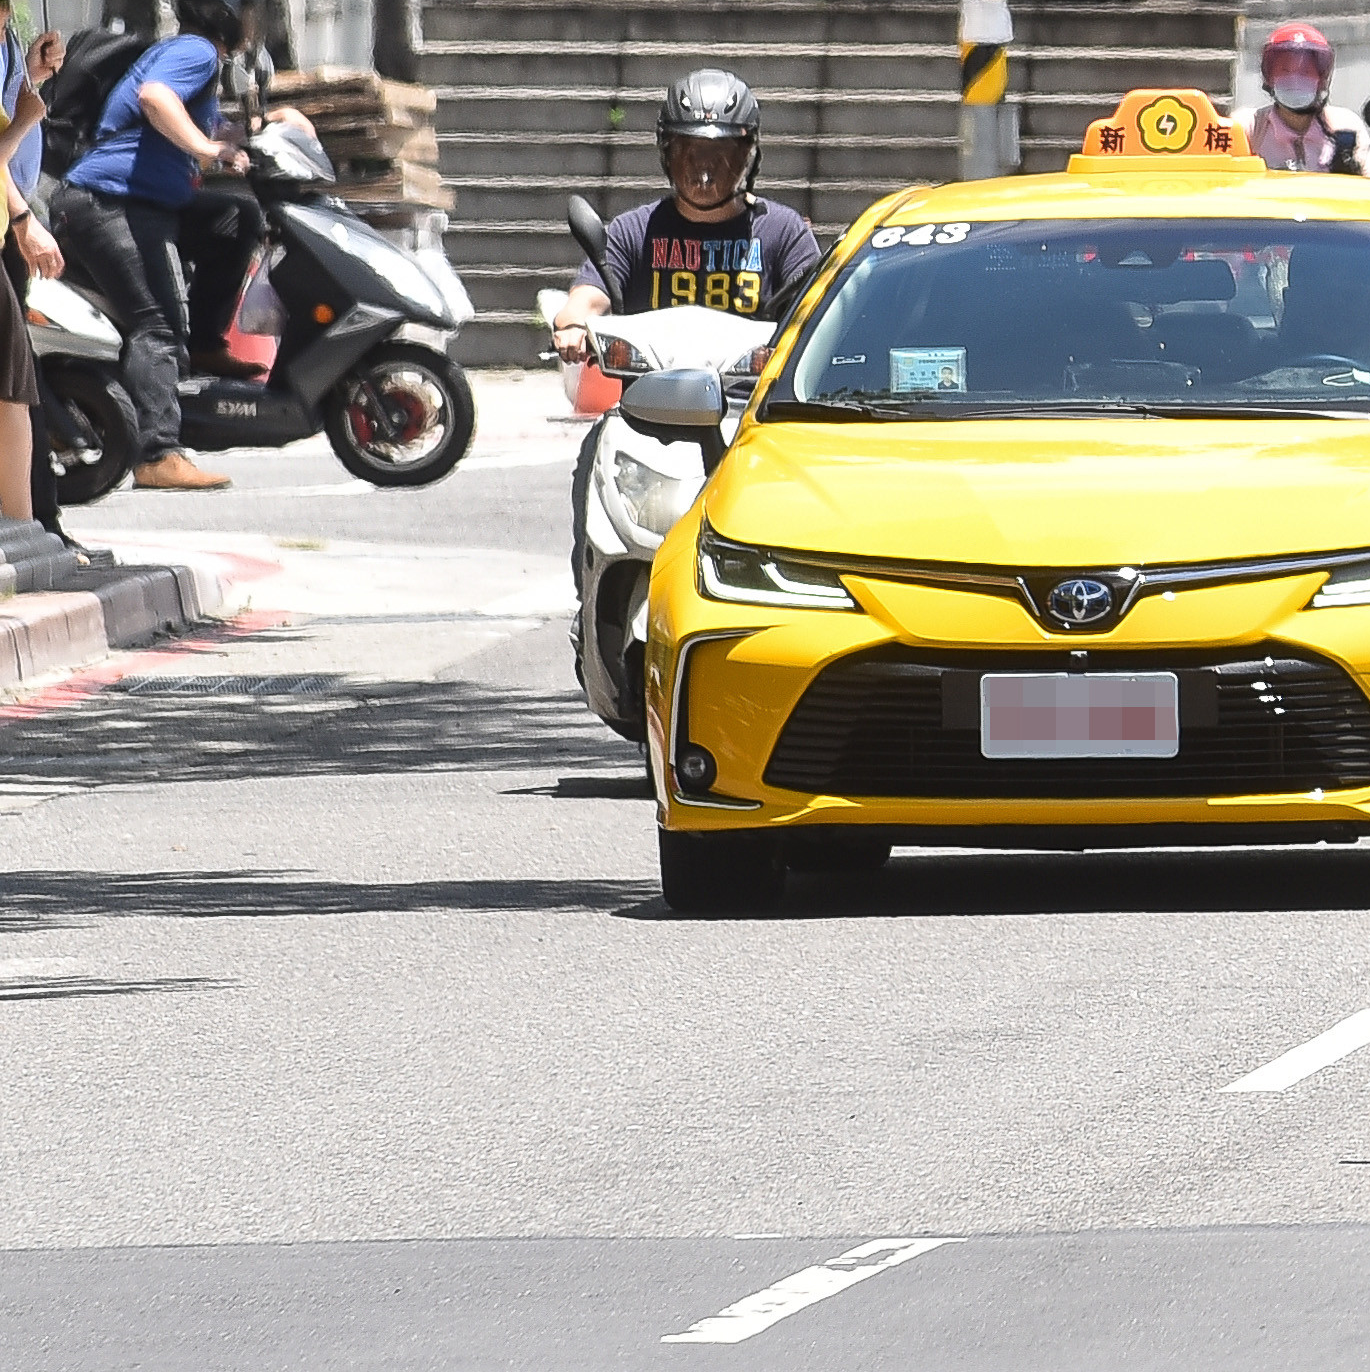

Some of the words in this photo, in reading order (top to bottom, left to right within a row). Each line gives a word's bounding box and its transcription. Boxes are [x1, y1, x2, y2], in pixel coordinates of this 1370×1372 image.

[1099, 126, 1126, 154] 新
[1204, 123, 1233, 153] 梅
[871, 222, 971, 249] 643
[651, 237, 763, 272] NAUTICA
[651, 270, 761, 314] 1983
